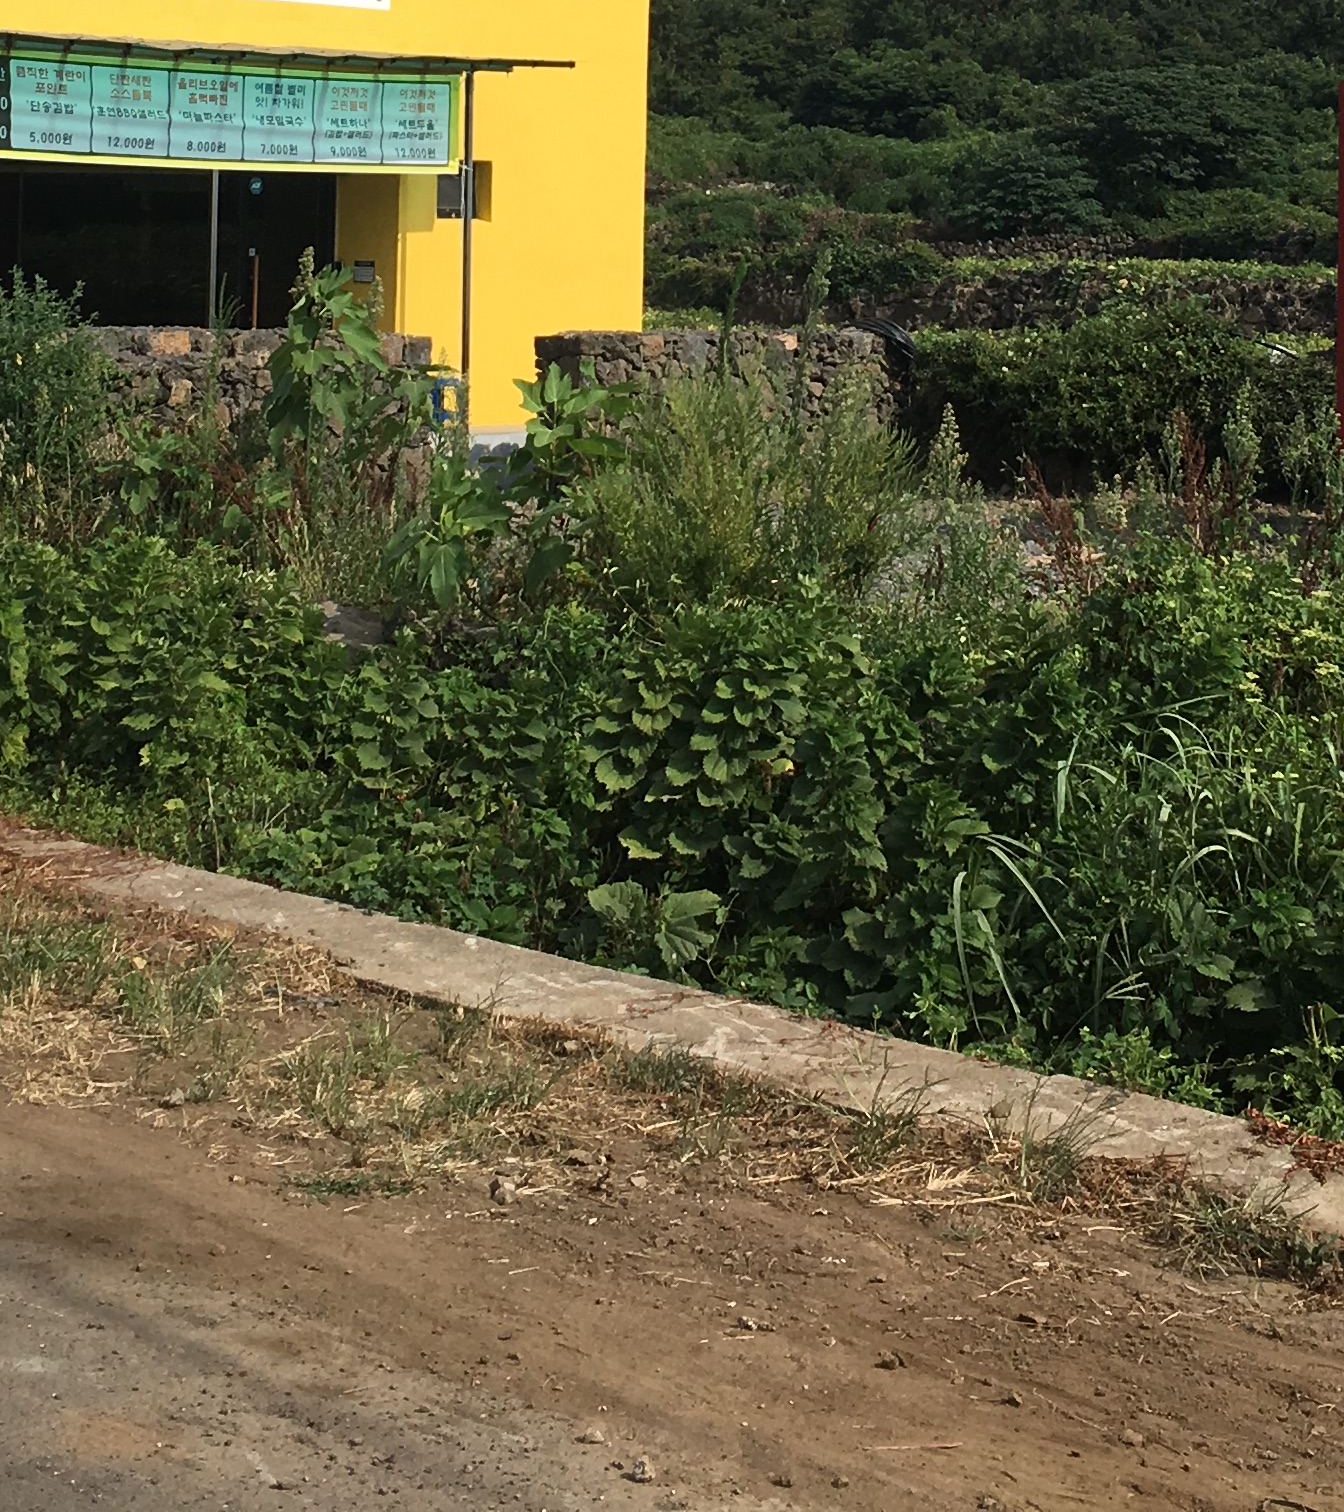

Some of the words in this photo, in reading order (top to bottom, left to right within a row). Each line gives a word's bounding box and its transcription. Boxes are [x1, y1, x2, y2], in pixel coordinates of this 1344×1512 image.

[54, 69, 86, 83] 계란이
[35, 82, 68, 95] 포인트
[178, 77, 238, 92] 올리브오일에
[287, 84, 306, 96] 별미
[331, 86, 368, 98] 이것저것
[399, 88, 436, 100] 이것저것
